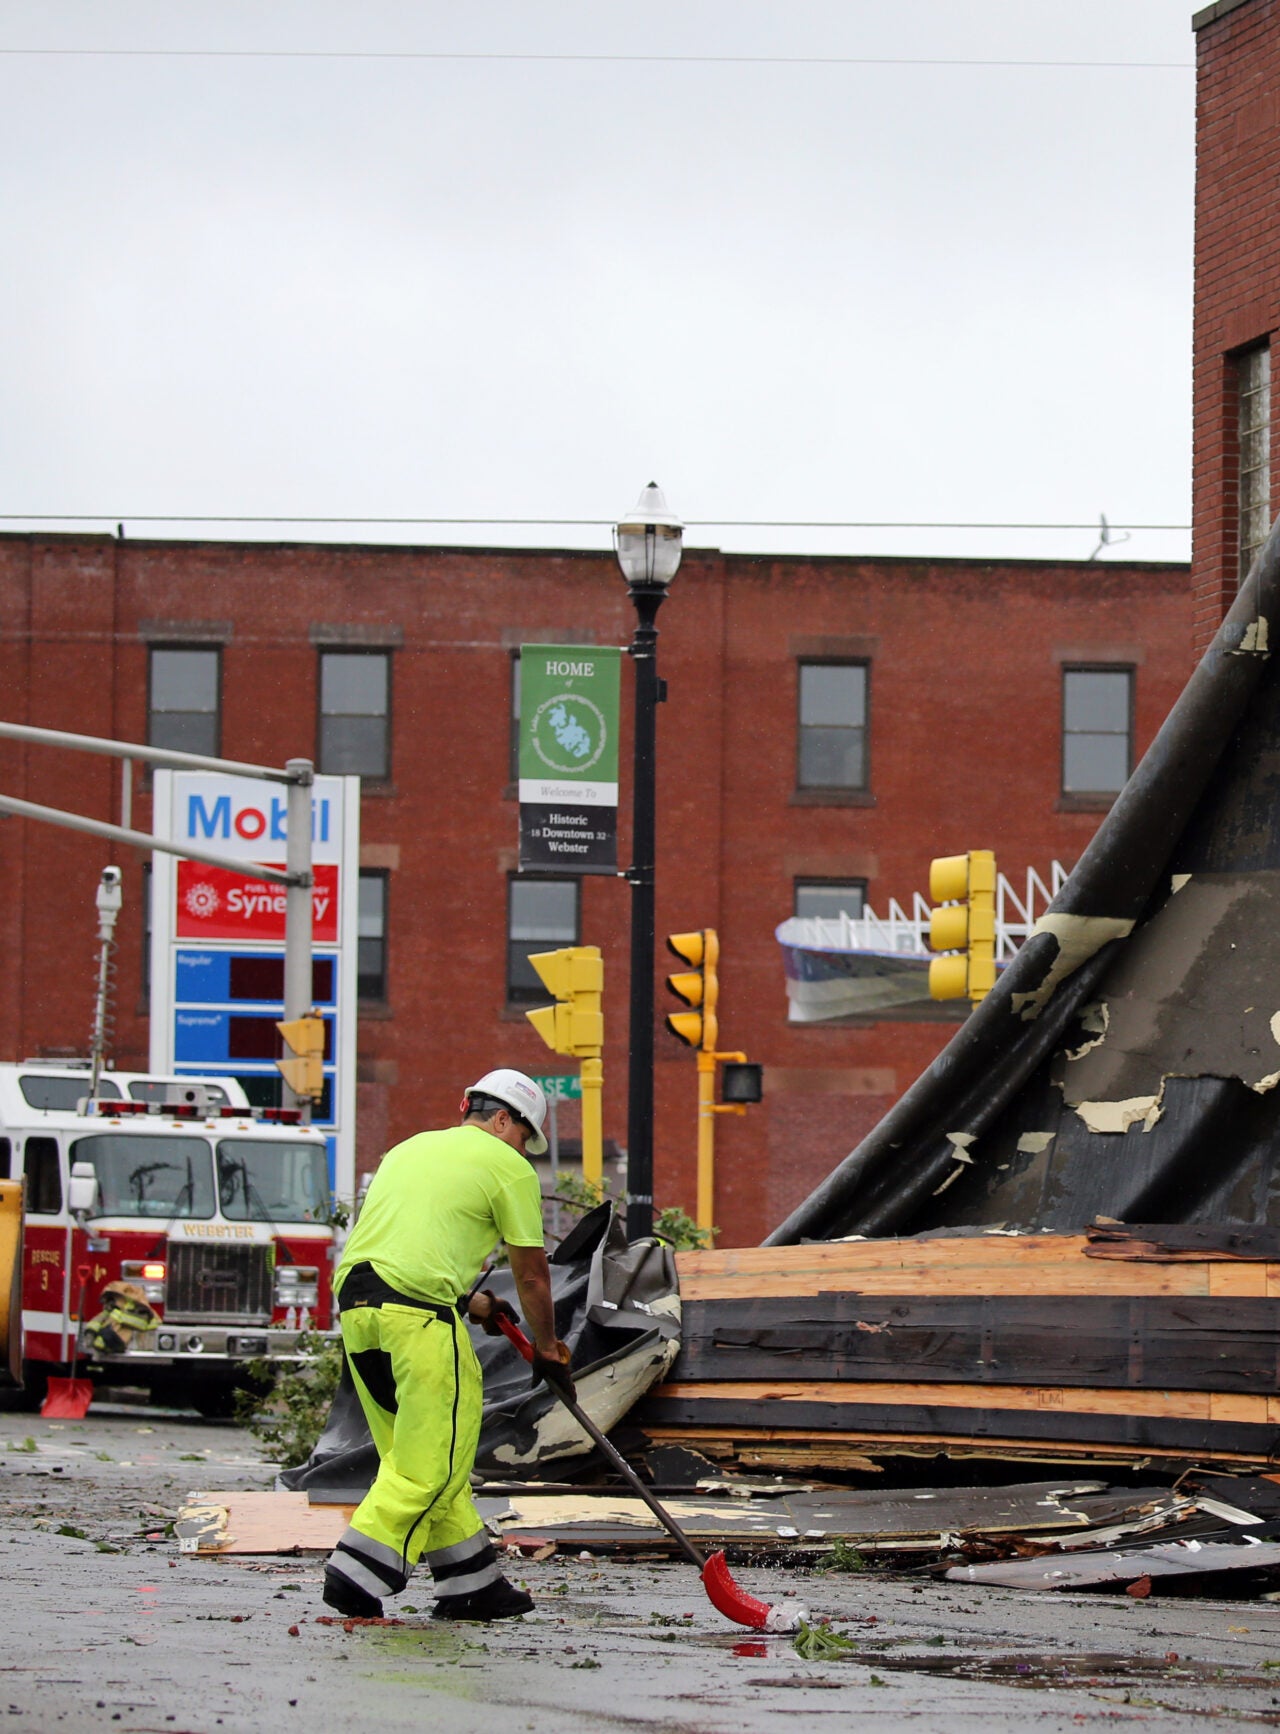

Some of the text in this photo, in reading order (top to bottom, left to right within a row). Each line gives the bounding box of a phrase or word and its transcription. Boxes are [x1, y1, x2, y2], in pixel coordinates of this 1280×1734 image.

[546, 661, 594, 676] HOME
[541, 786, 597, 798] Welcome To
[549, 813, 588, 825] Historic
[542, 827, 594, 840] Downtown
[548, 841, 589, 853] Webster
[244, 884, 267, 893] FUEL
[226, 888, 330, 921] Syney
[536, 1078, 566, 1096] ASE
[183, 1223, 255, 1238] WEBSTER
[31, 1249, 61, 1267] RESCUE
[41, 1269, 48, 1291] 3
